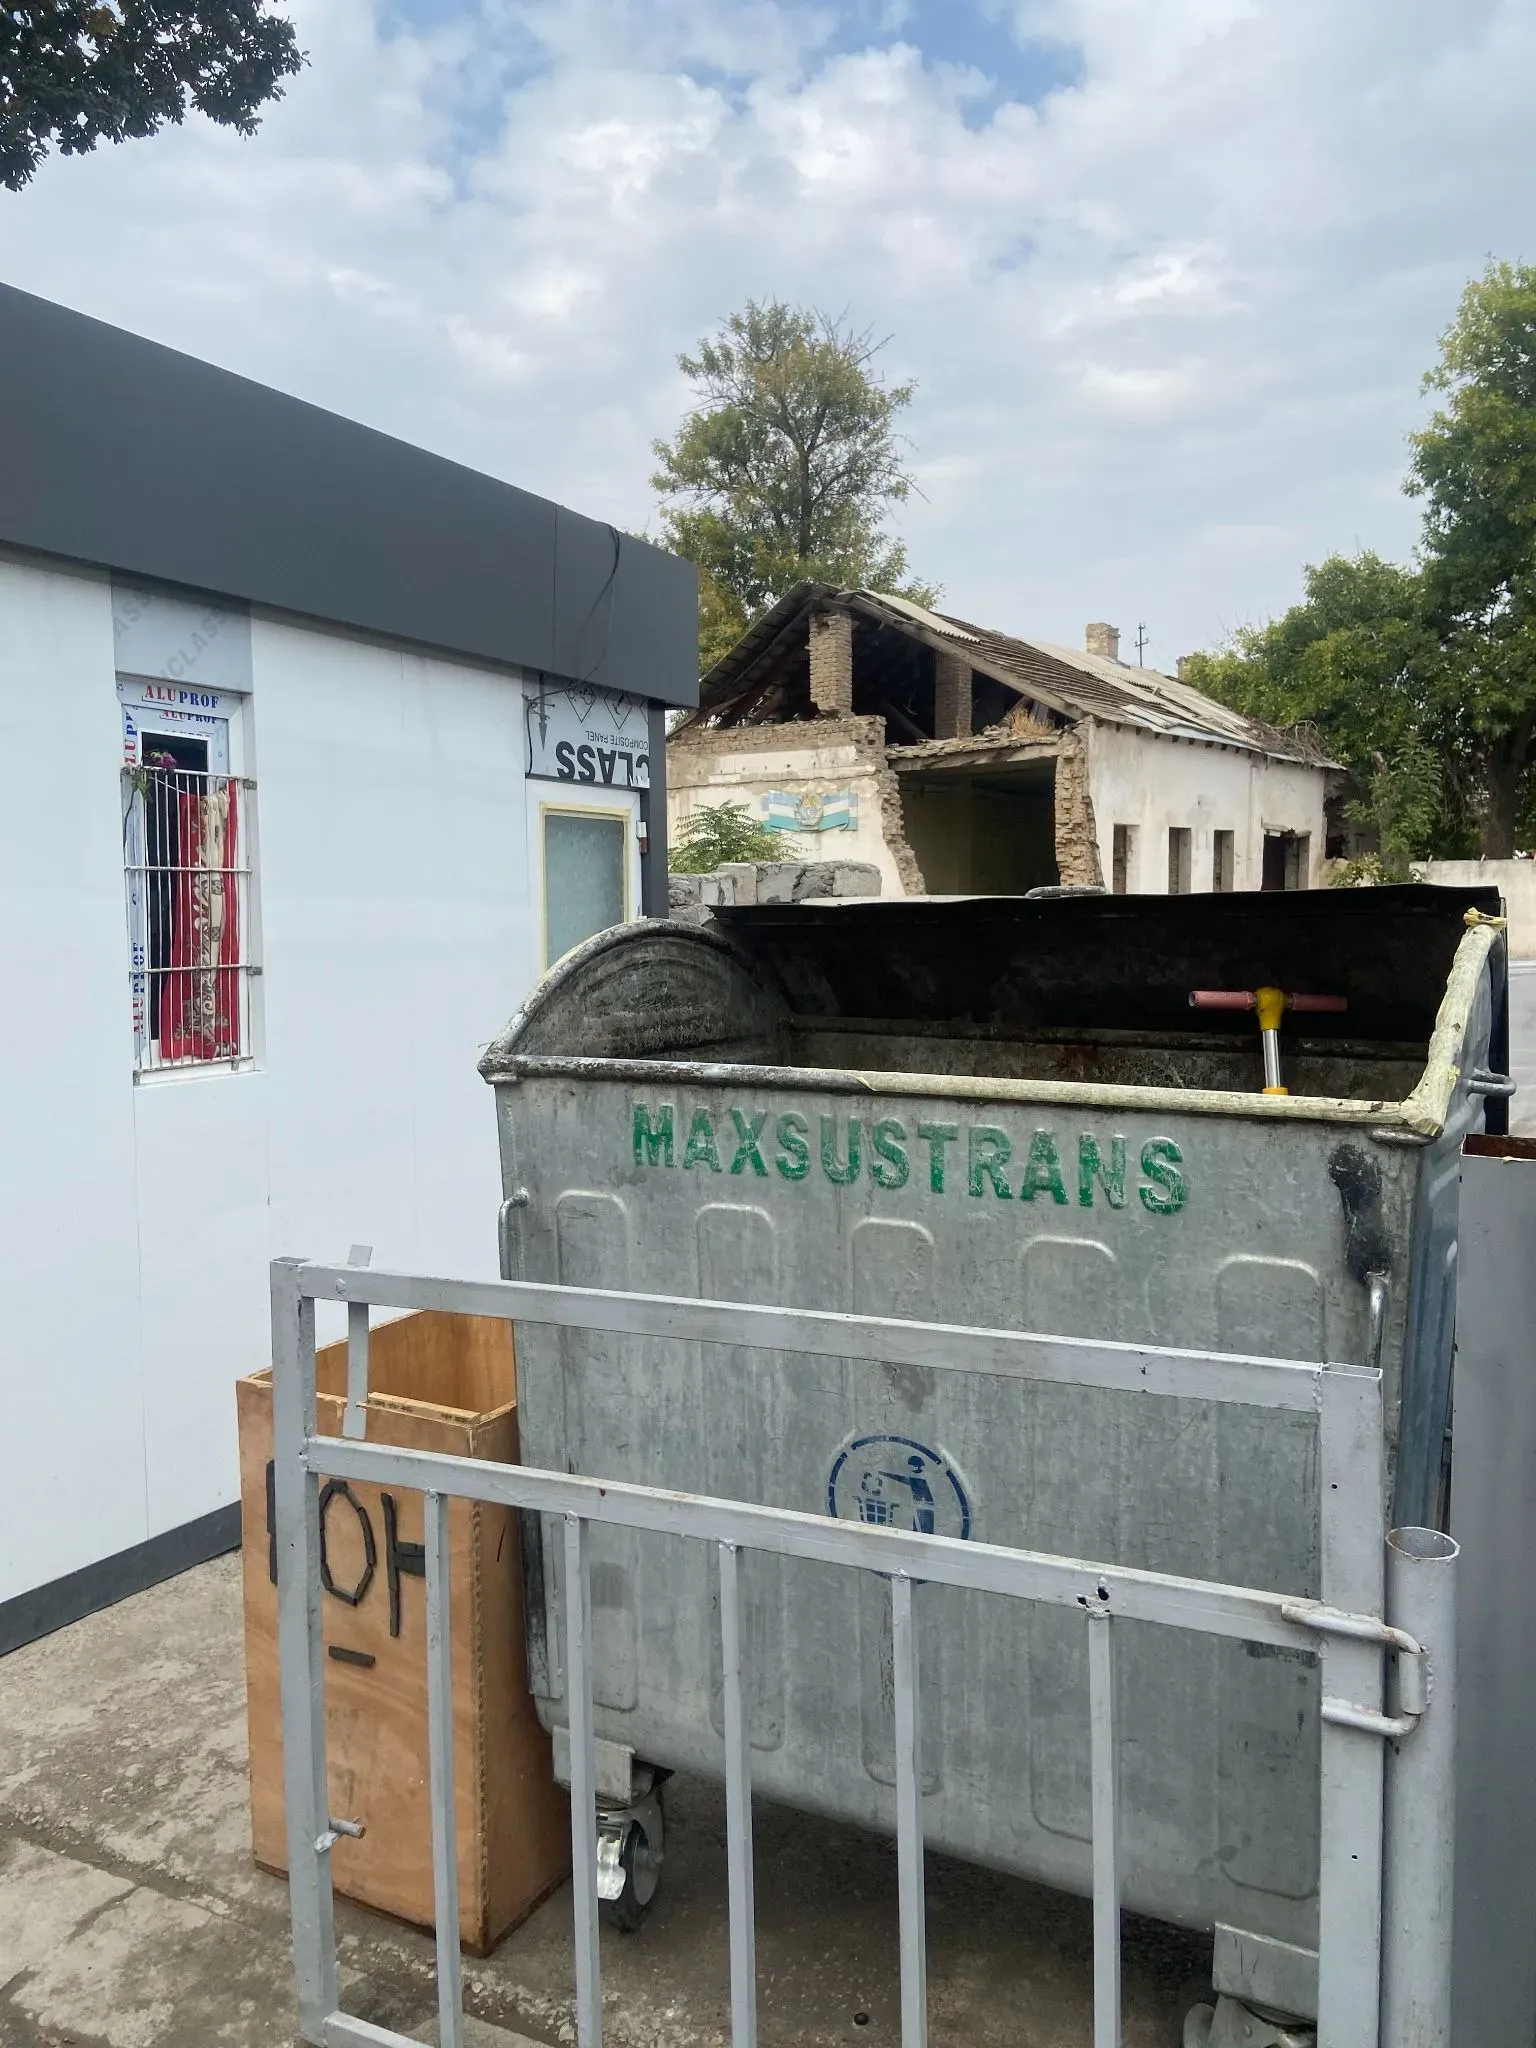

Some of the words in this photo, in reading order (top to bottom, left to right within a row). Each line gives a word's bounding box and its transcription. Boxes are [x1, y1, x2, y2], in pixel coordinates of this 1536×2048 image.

[145, 685, 219, 708] ALUPROF
[586, 730, 609, 744] PANEL
[610, 734, 648, 750] COMPOSITE
[631, 1101, 1191, 1217] MAXSUSTRANS
